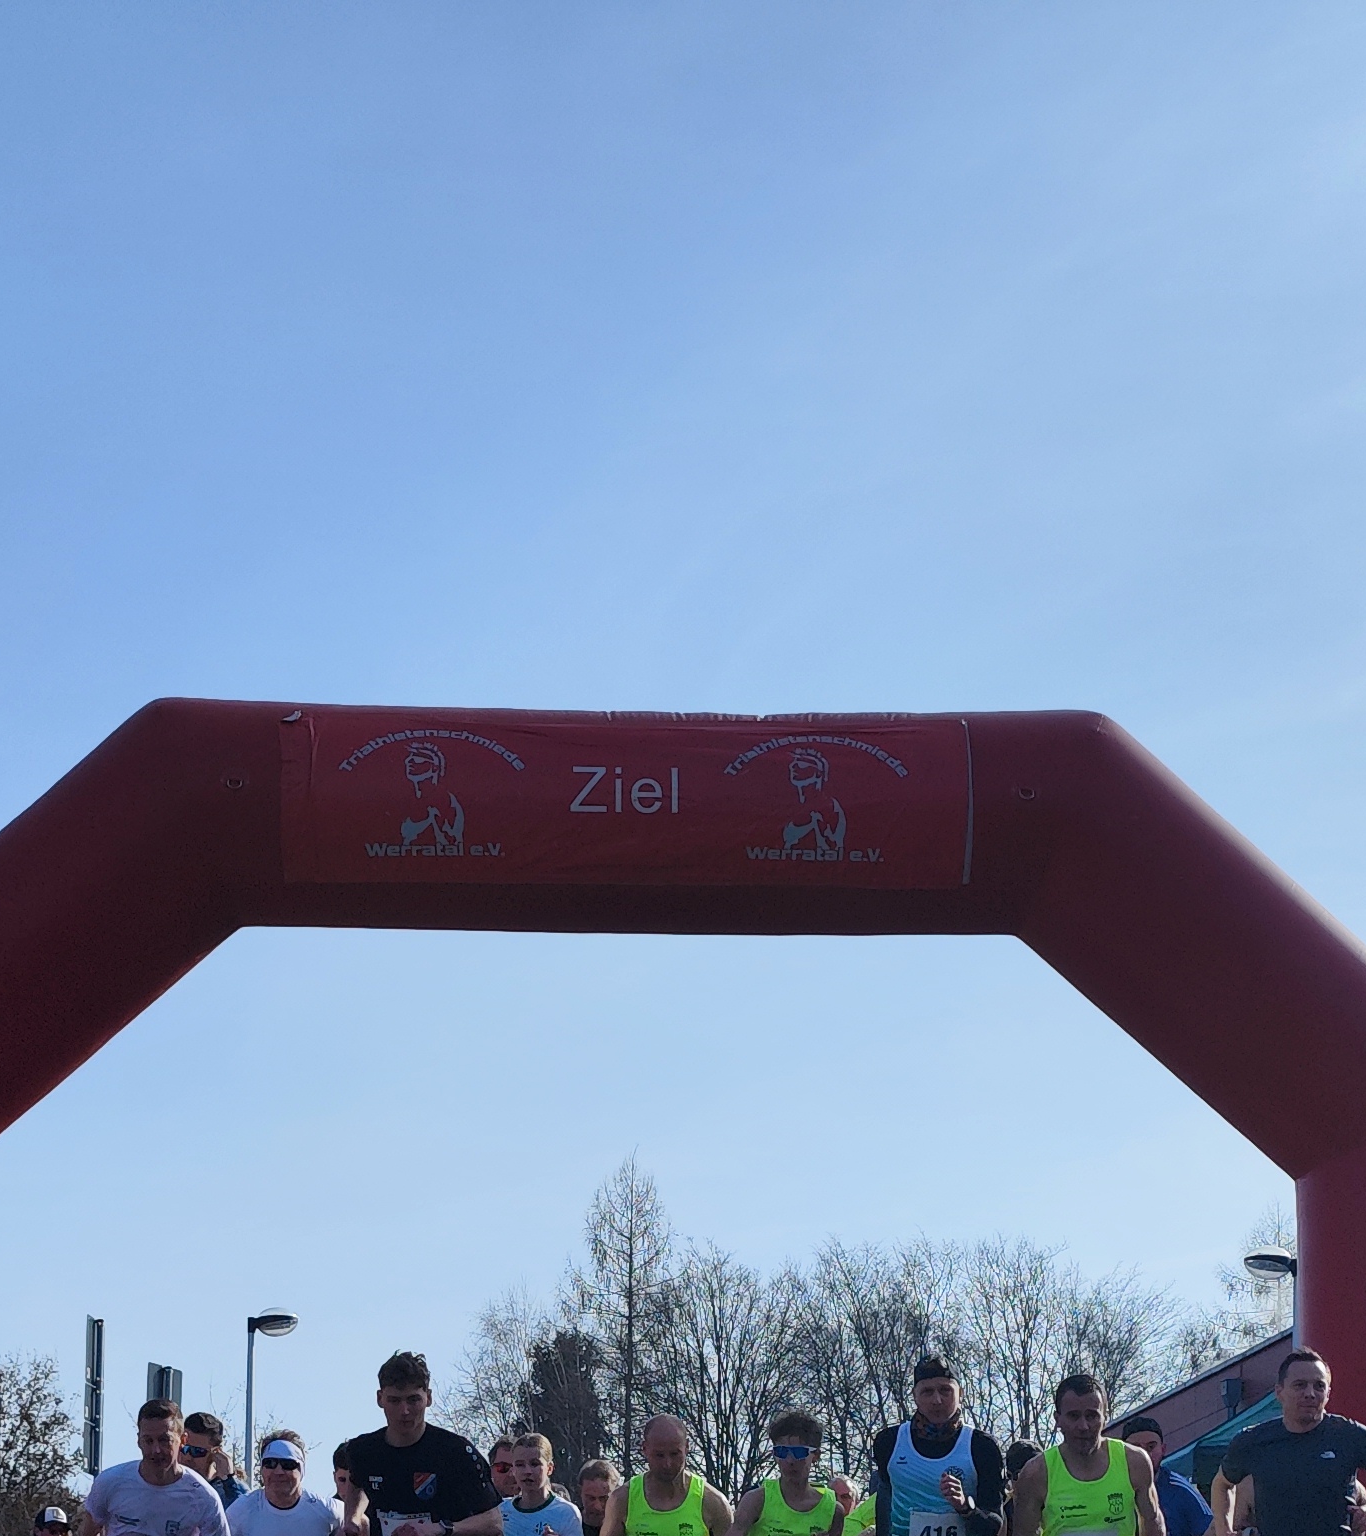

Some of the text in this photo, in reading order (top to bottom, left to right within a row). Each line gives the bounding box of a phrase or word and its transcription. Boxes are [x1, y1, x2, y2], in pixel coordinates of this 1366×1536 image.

[338, 729, 526, 772] Triathletenschmiede
[723, 735, 910, 778] Triathletenschmiede
[570, 765, 679, 814] Ziel
[364, 842, 506, 857] Werratal e.V.
[746, 846, 885, 862] Werratal e.V.
